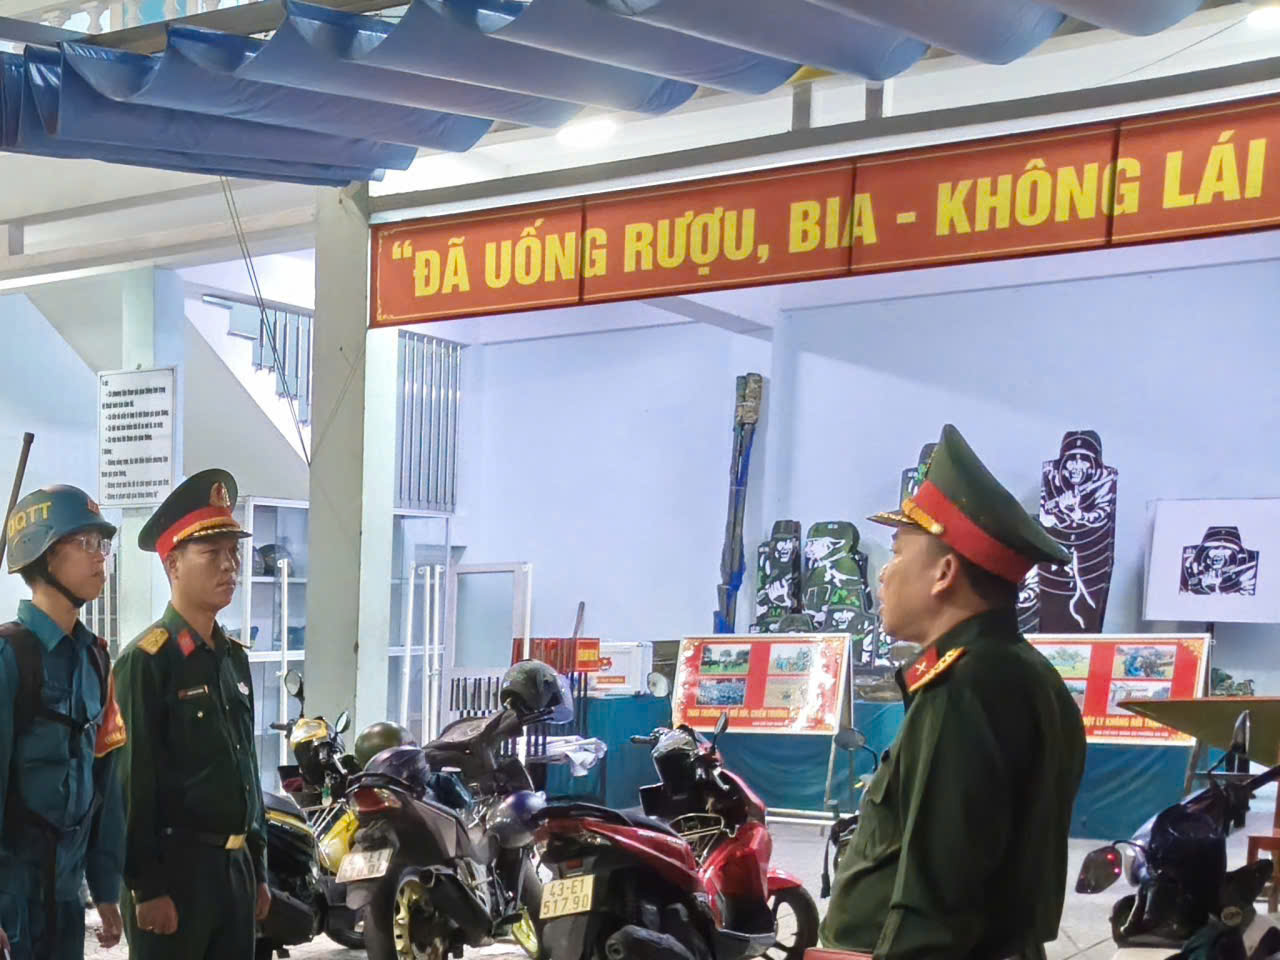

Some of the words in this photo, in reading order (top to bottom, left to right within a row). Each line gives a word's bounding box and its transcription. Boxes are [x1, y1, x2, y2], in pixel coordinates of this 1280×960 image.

[485, 218, 608, 288] UỐNG
[624, 206, 769, 276] RƯỢU,
[789, 193, 877, 253] BIA
[936, 158, 1141, 236] KHÔNG
[1163, 130, 1267, 209] LÁI
[542, 895, 589, 915] 517.90
